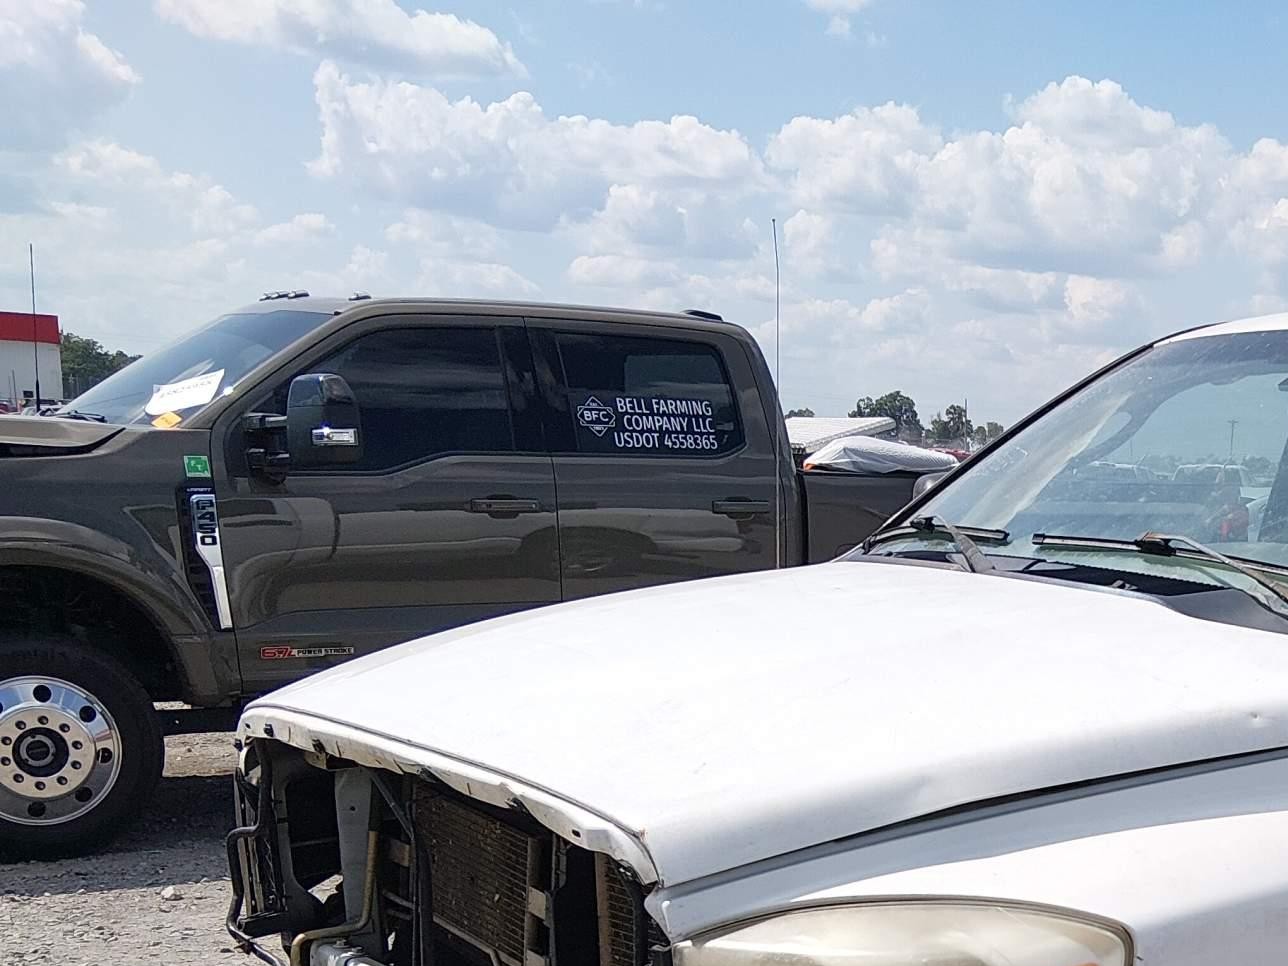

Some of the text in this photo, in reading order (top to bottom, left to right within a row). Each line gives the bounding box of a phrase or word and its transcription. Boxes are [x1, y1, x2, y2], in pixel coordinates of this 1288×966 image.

[616, 397, 712, 416] BELL FARMING
[583, 410, 609, 421] BFC
[623, 415, 715, 432] COMPANY LLC
[614, 432, 718, 449] USDOT 4558365
